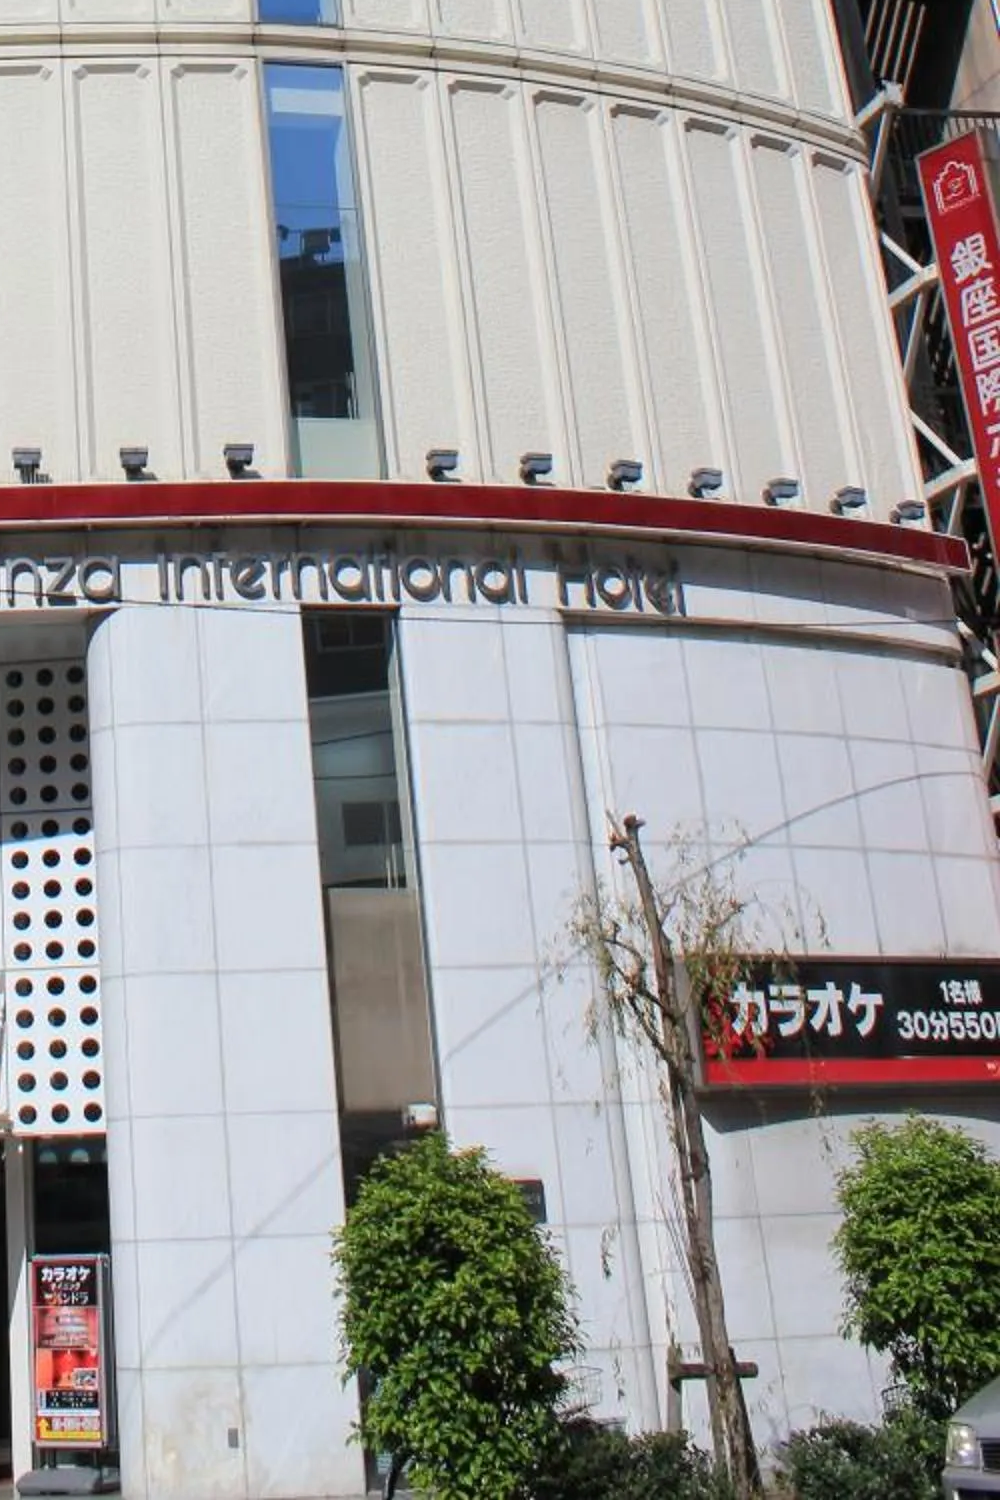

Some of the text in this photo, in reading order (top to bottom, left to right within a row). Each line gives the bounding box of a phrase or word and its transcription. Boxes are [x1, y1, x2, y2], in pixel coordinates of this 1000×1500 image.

[157, 547, 528, 605] International
[556, 544, 688, 617] Hotel
[939, 980, 983, 1004] 1名様
[729, 980, 883, 1038] カラオケ
[896, 1010, 1000, 1040] 30分550
[41, 1266, 91, 1282] カラオケ
